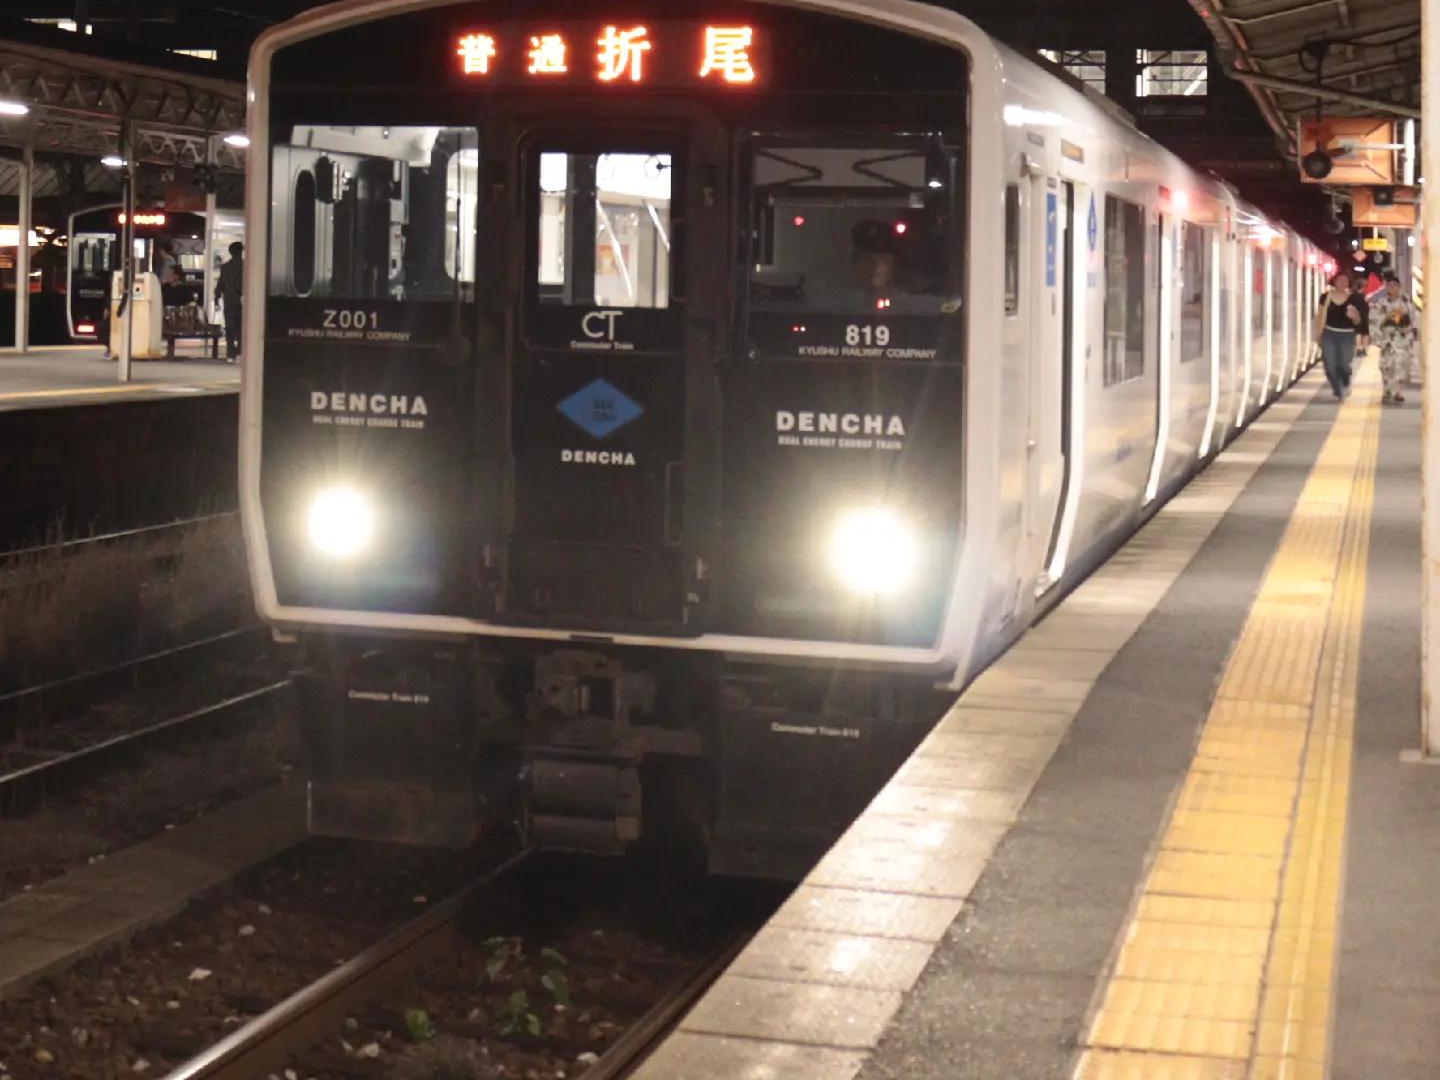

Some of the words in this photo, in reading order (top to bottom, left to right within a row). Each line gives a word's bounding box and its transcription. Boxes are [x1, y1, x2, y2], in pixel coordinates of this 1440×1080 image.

[456, 33, 568, 75] 普通
[597, 24, 756, 82] 折尾
[323, 310, 378, 329] Z001
[582, 310, 624, 341] CT
[366, 331, 411, 341] COMPANY
[845, 324, 890, 346] 819
[798, 345, 839, 356] KYUSHU
[886, 348, 936, 359] COMPANY
[311, 391, 428, 416] DENCHA
[776, 410, 905, 436] DENCHA
[561, 449, 636, 466] DENCHA
